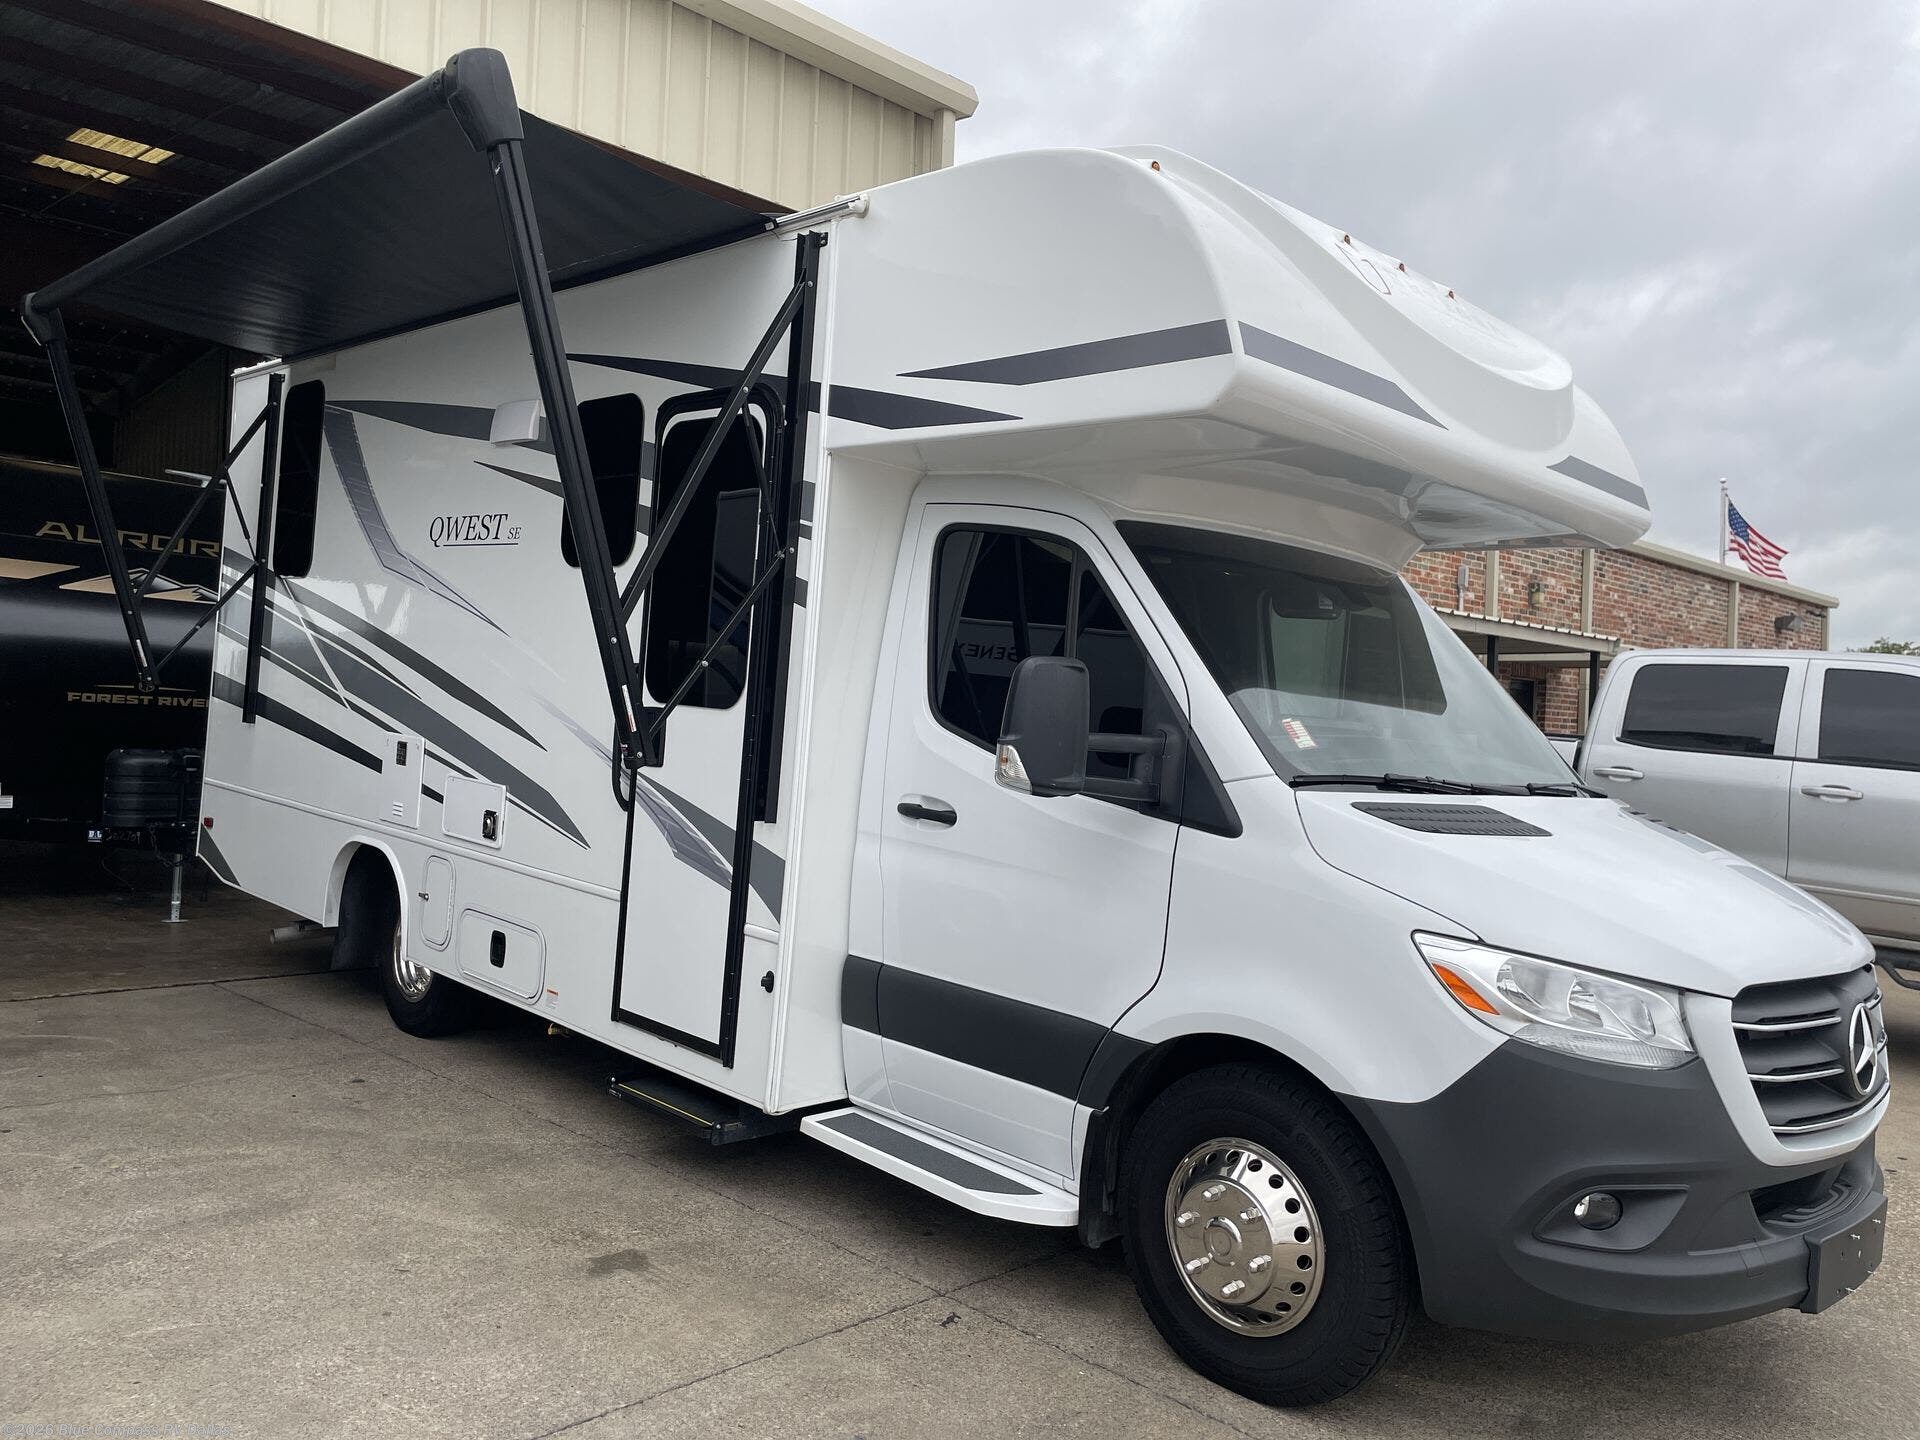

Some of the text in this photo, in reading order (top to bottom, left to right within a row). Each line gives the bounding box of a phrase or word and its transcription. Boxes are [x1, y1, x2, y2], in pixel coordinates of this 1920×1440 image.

[430, 514, 521, 547] QWEST SE
[67, 692, 153, 705] FOREST
